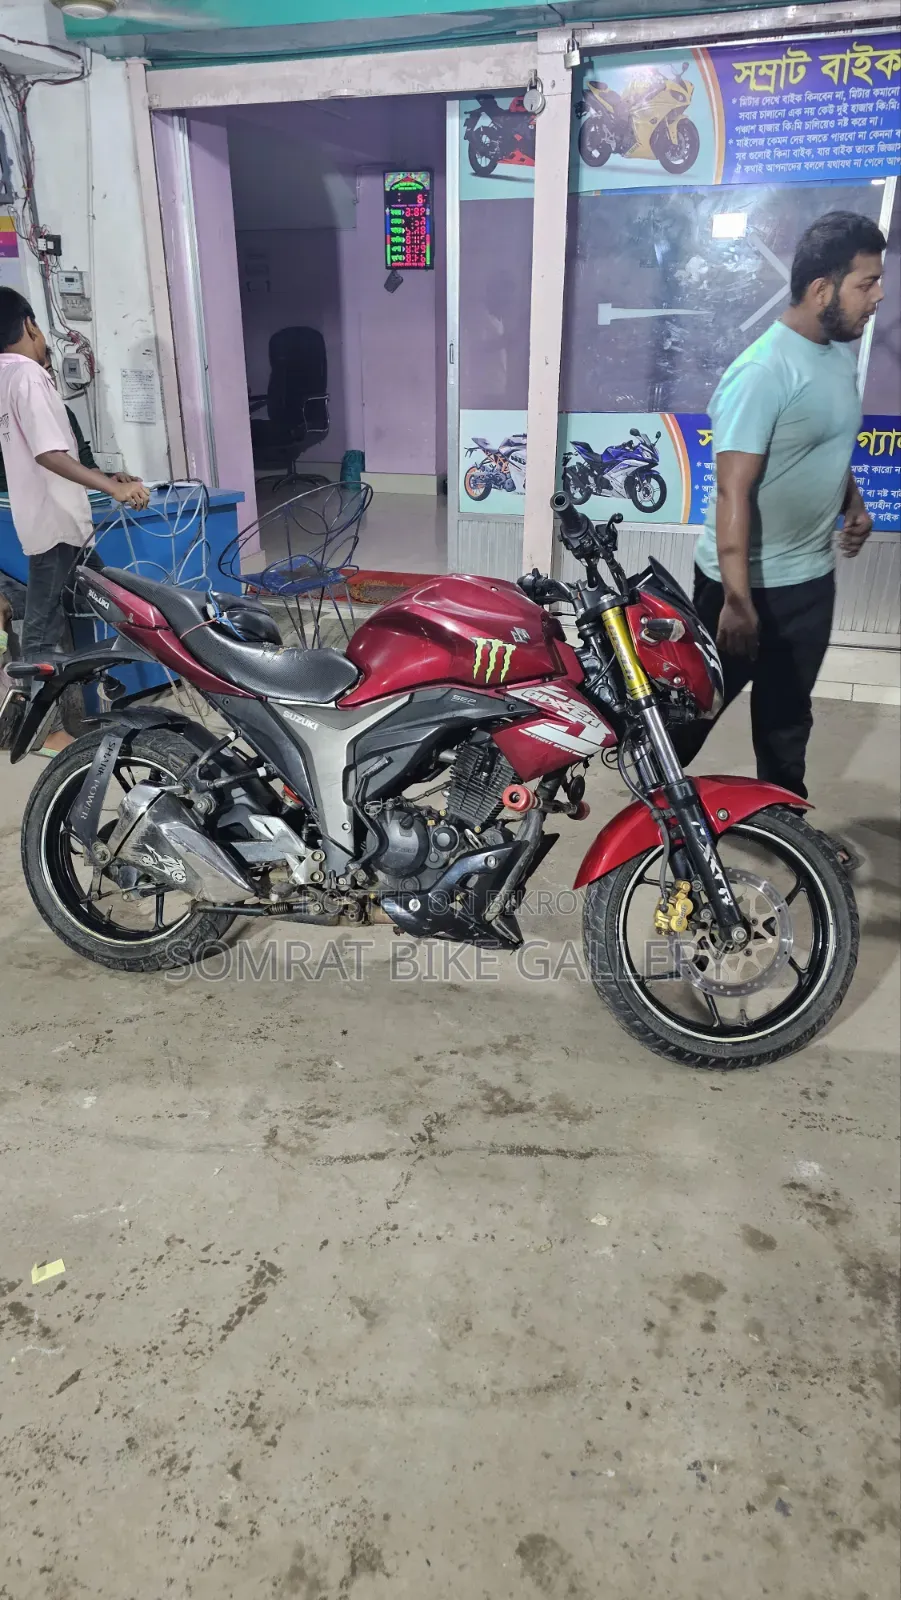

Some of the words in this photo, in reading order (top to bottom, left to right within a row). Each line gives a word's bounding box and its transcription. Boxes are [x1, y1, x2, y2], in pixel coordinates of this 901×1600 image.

[732, 47, 812, 94] সম্রাট
[819, 42, 901, 86] বাইক
[739, 95, 760, 107] মিটার
[762, 95, 780, 106] দেখে
[782, 93, 803, 104] বাইক
[804, 91, 834, 103] কিনবেন
[849, 87, 871, 100] মিটার
[873, 86, 900, 97] কমানো
[738, 111, 758, 120] সবার
[759, 108, 786, 119] চালানো
[788, 107, 802, 118] এক
[818, 103, 835, 116] কেউ
[836, 102, 849, 116] দুই
[850, 102, 874, 115] হাজার
[758, 123, 781, 134] হাজার
[851, 117, 868, 127] করে
[736, 136, 765, 148] মাইলেজ
[767, 136, 789, 146] কেমন
[807, 133, 829, 143] বলতে
[830, 131, 856, 142] পারবো
[858, 131, 867, 140] না
[868, 129, 894, 140] কেননা
[832, 144, 854, 155] বাইক
[855, 144, 876, 154] তাকে
[765, 162, 802, 173] আপনাদের
[853, 158, 862, 168] না
[871, 464, 893, 474] কারো
[878, 511, 900, 523] বাইক
[88, 589, 109, 610] SUZUKI
[282, 710, 319, 731] SUZUKI
[95, 741, 116, 777] SHARK
[80, 779, 100, 820] POWER
